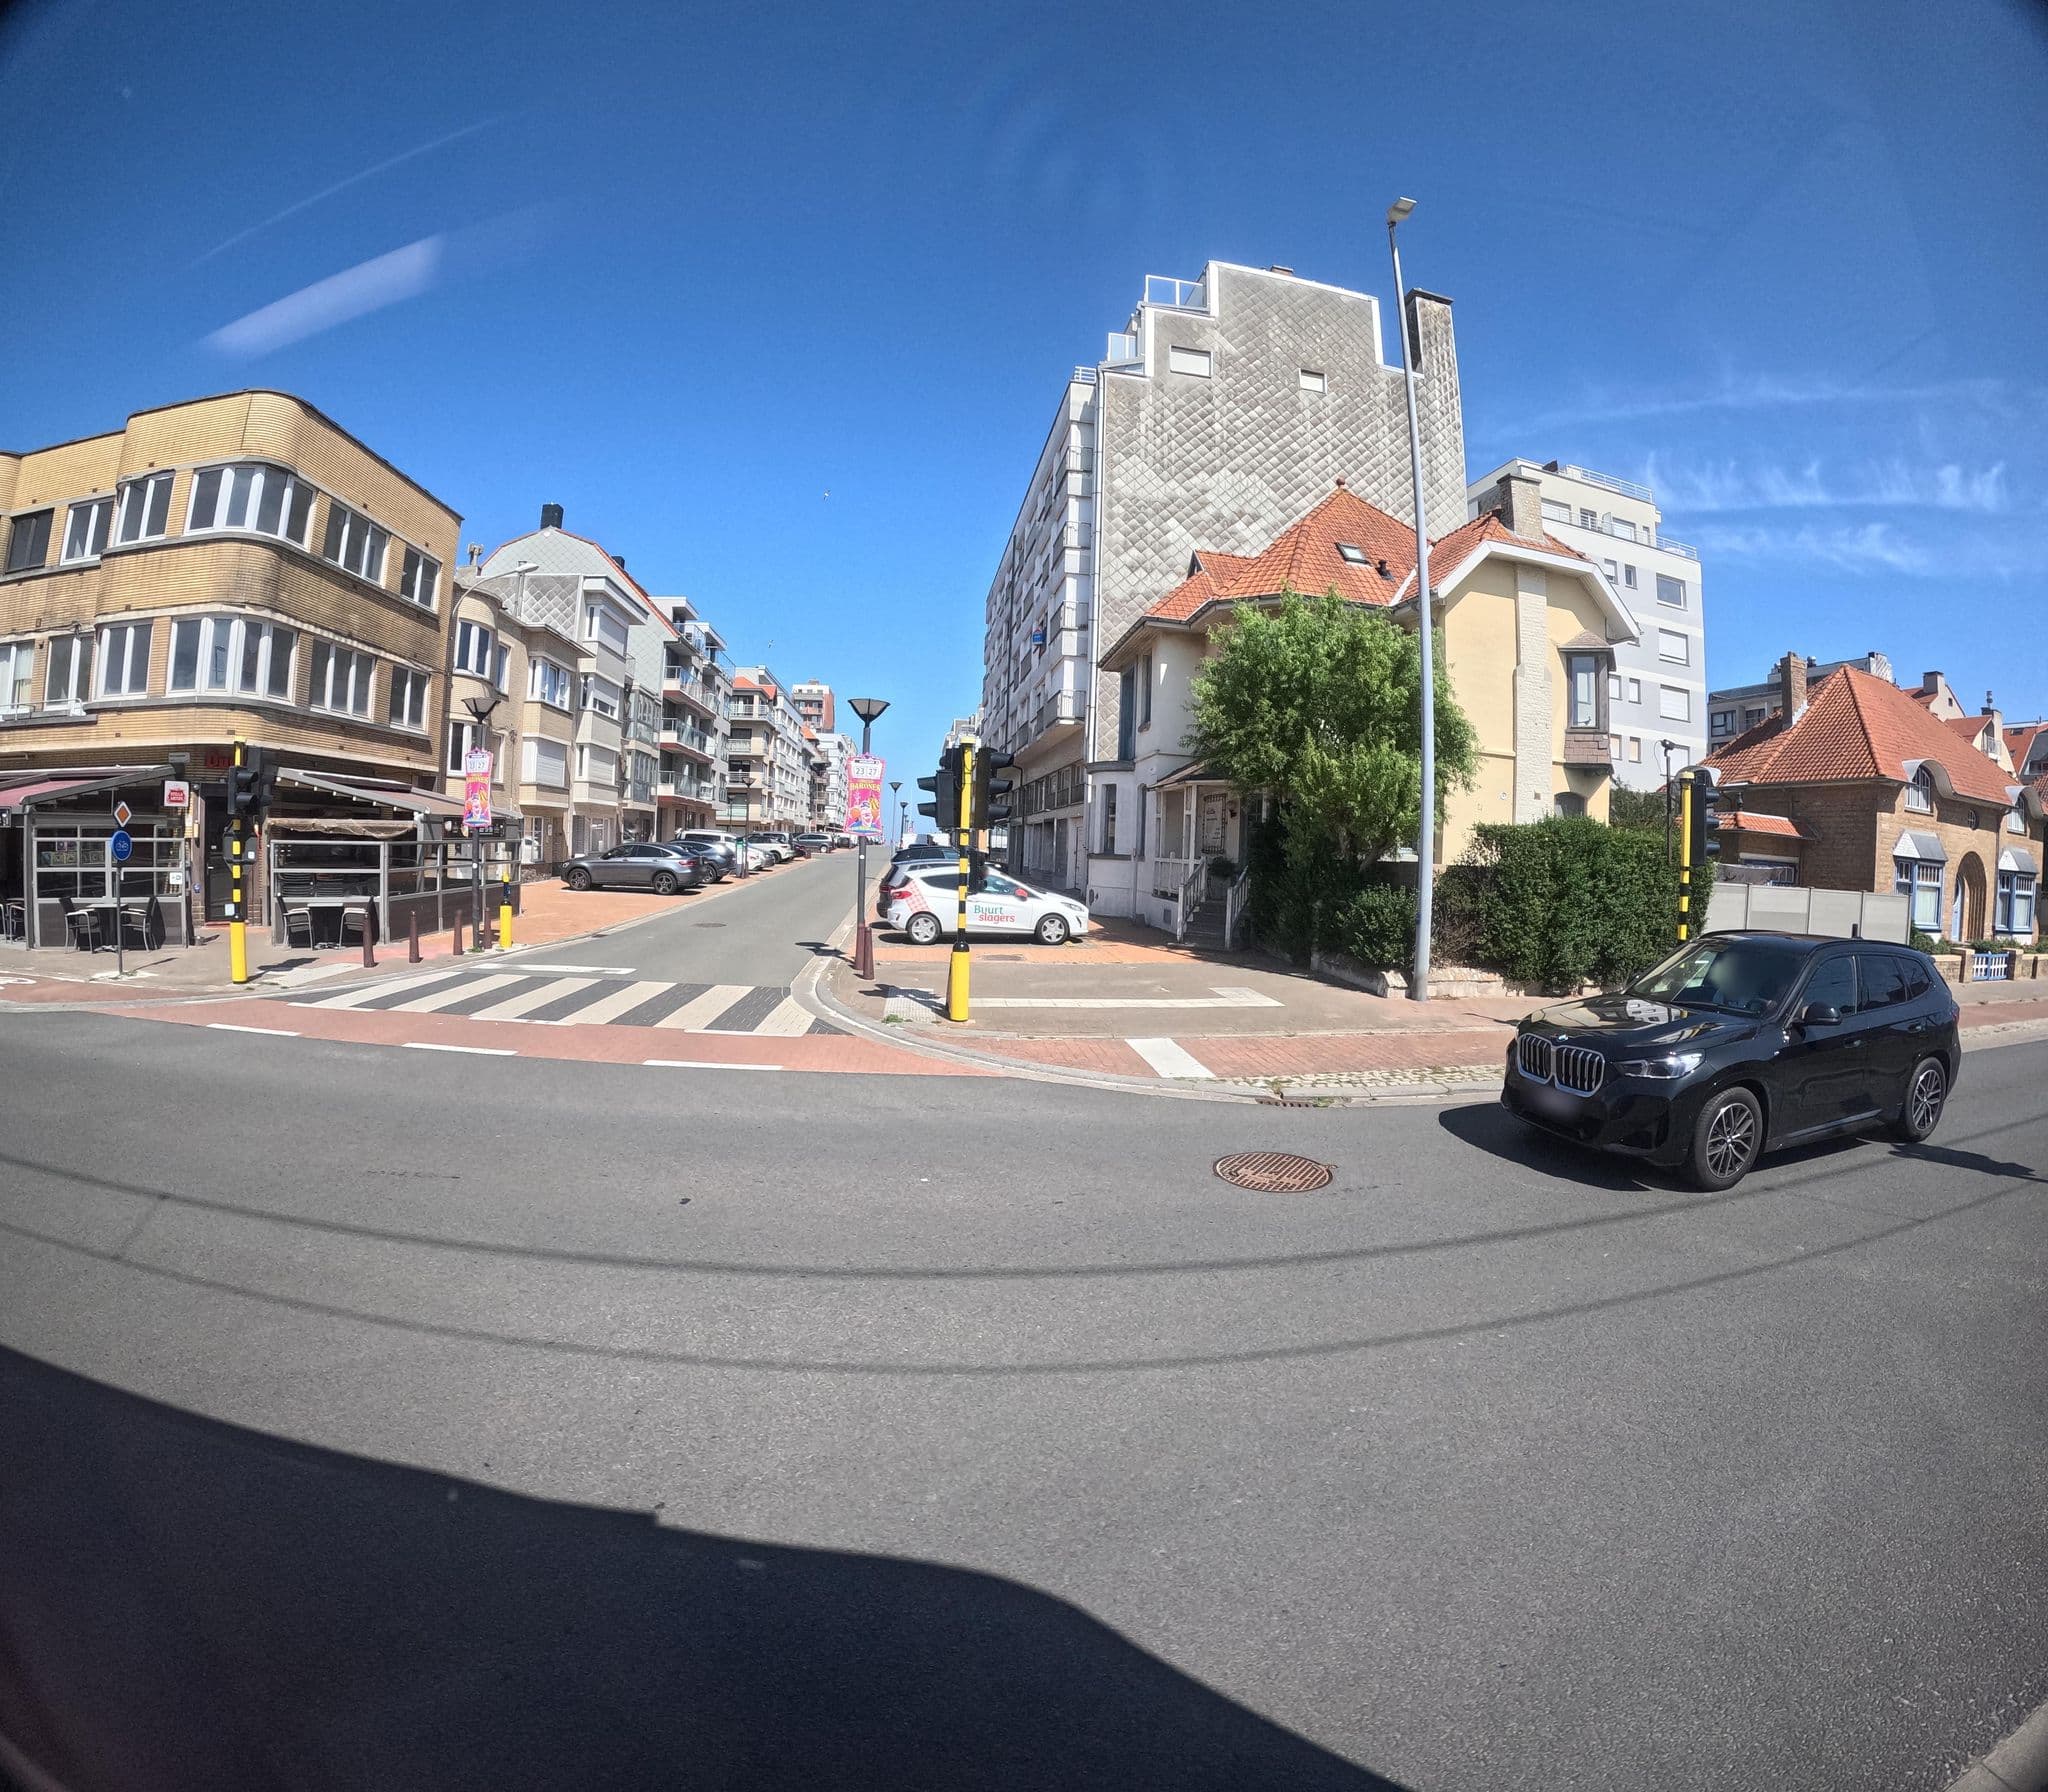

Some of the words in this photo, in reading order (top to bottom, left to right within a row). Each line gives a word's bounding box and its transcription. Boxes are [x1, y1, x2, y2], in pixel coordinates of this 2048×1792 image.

[856, 767, 865, 775] 23
[869, 768, 877, 776] 27
[974, 904, 1003, 915] Buurt
[978, 913, 1015, 924] slagers
